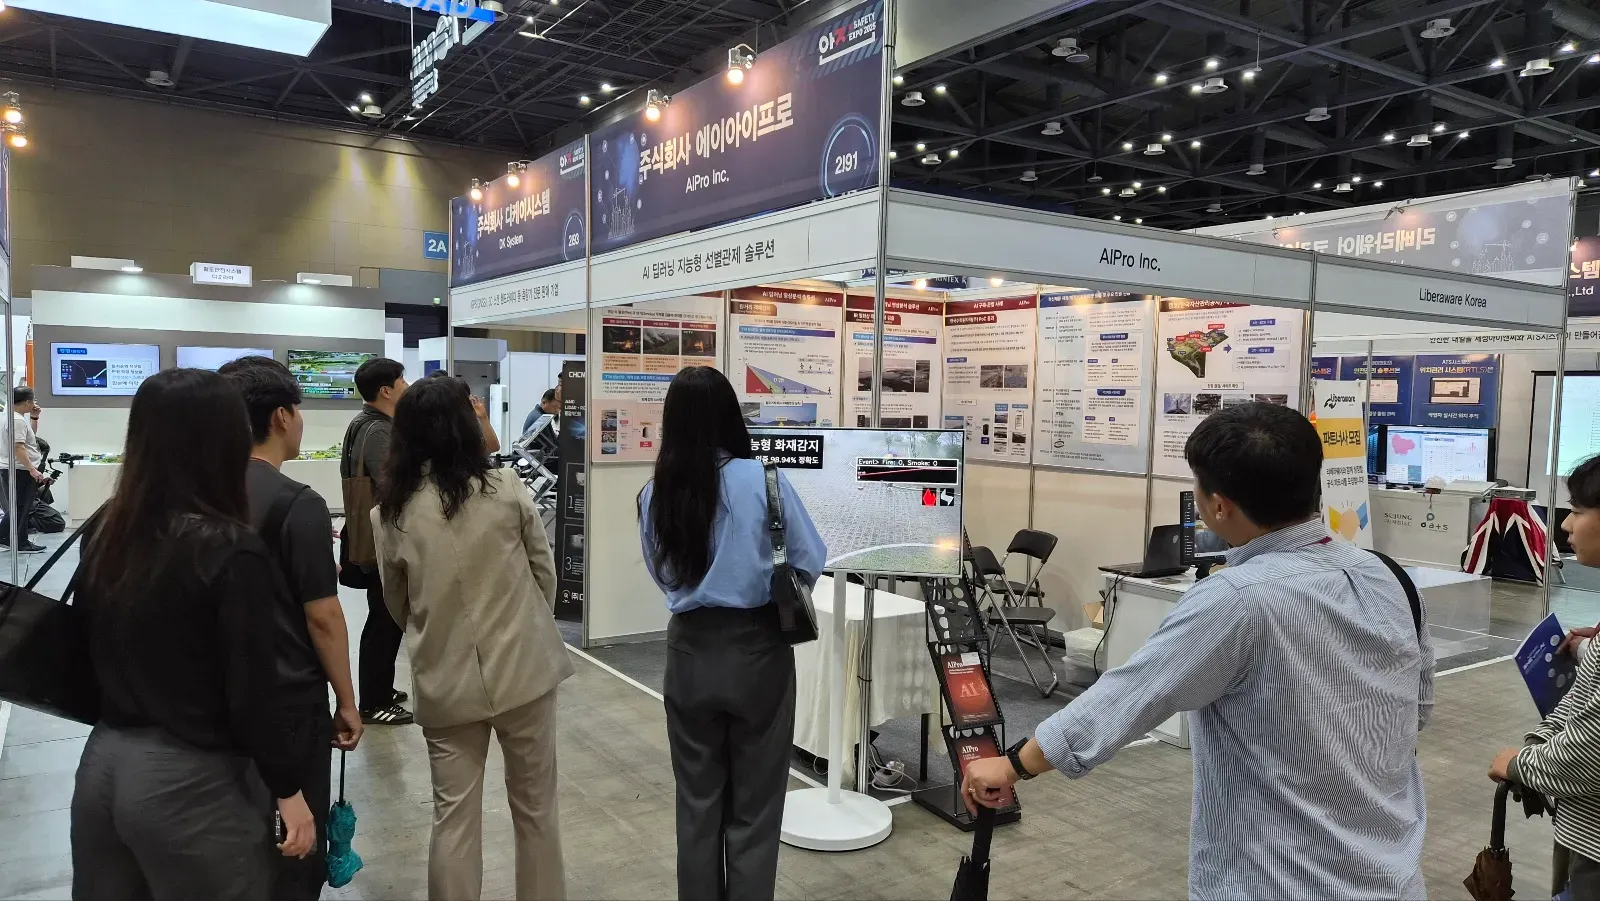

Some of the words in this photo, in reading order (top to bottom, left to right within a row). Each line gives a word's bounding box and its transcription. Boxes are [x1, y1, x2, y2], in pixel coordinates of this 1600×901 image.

[853, 11, 875, 29] SAFETY
[848, 28, 863, 42] EXPO
[863, 21, 877, 35] 2025
[639, 132, 691, 180] 주식회사
[695, 92, 794, 158] 에이아이프로
[685, 174, 710, 193] AIPro
[712, 169, 730, 184] Inc.
[477, 212, 503, 238] 주식회사
[505, 188, 551, 226] 디케이시스템
[428, 238, 447, 253] 2A
[506, 233, 524, 249] System
[642, 265, 650, 280] AI
[652, 259, 675, 279] 딥러닝
[677, 252, 702, 274] 지능형
[704, 245, 741, 270] 선별관제
[744, 238, 775, 263] 솔루션
[1099, 248, 1135, 269] AIPro
[1139, 252, 1161, 272] Inc.
[1419, 287, 1463, 307] Liberaware
[1464, 293, 1488, 308] Korea
[750, 438, 772, 452] 능형
[774, 438, 820, 453] 화재감지
[1323, 430, 1348, 447] 파트너사
[1348, 429, 1361, 446] 모집
[798, 455, 820, 465] 정확도
[567, 495, 574, 509] 1
[565, 556, 572, 571] 3
[959, 682, 981, 699] AI
[962, 745, 979, 754] AIPro
